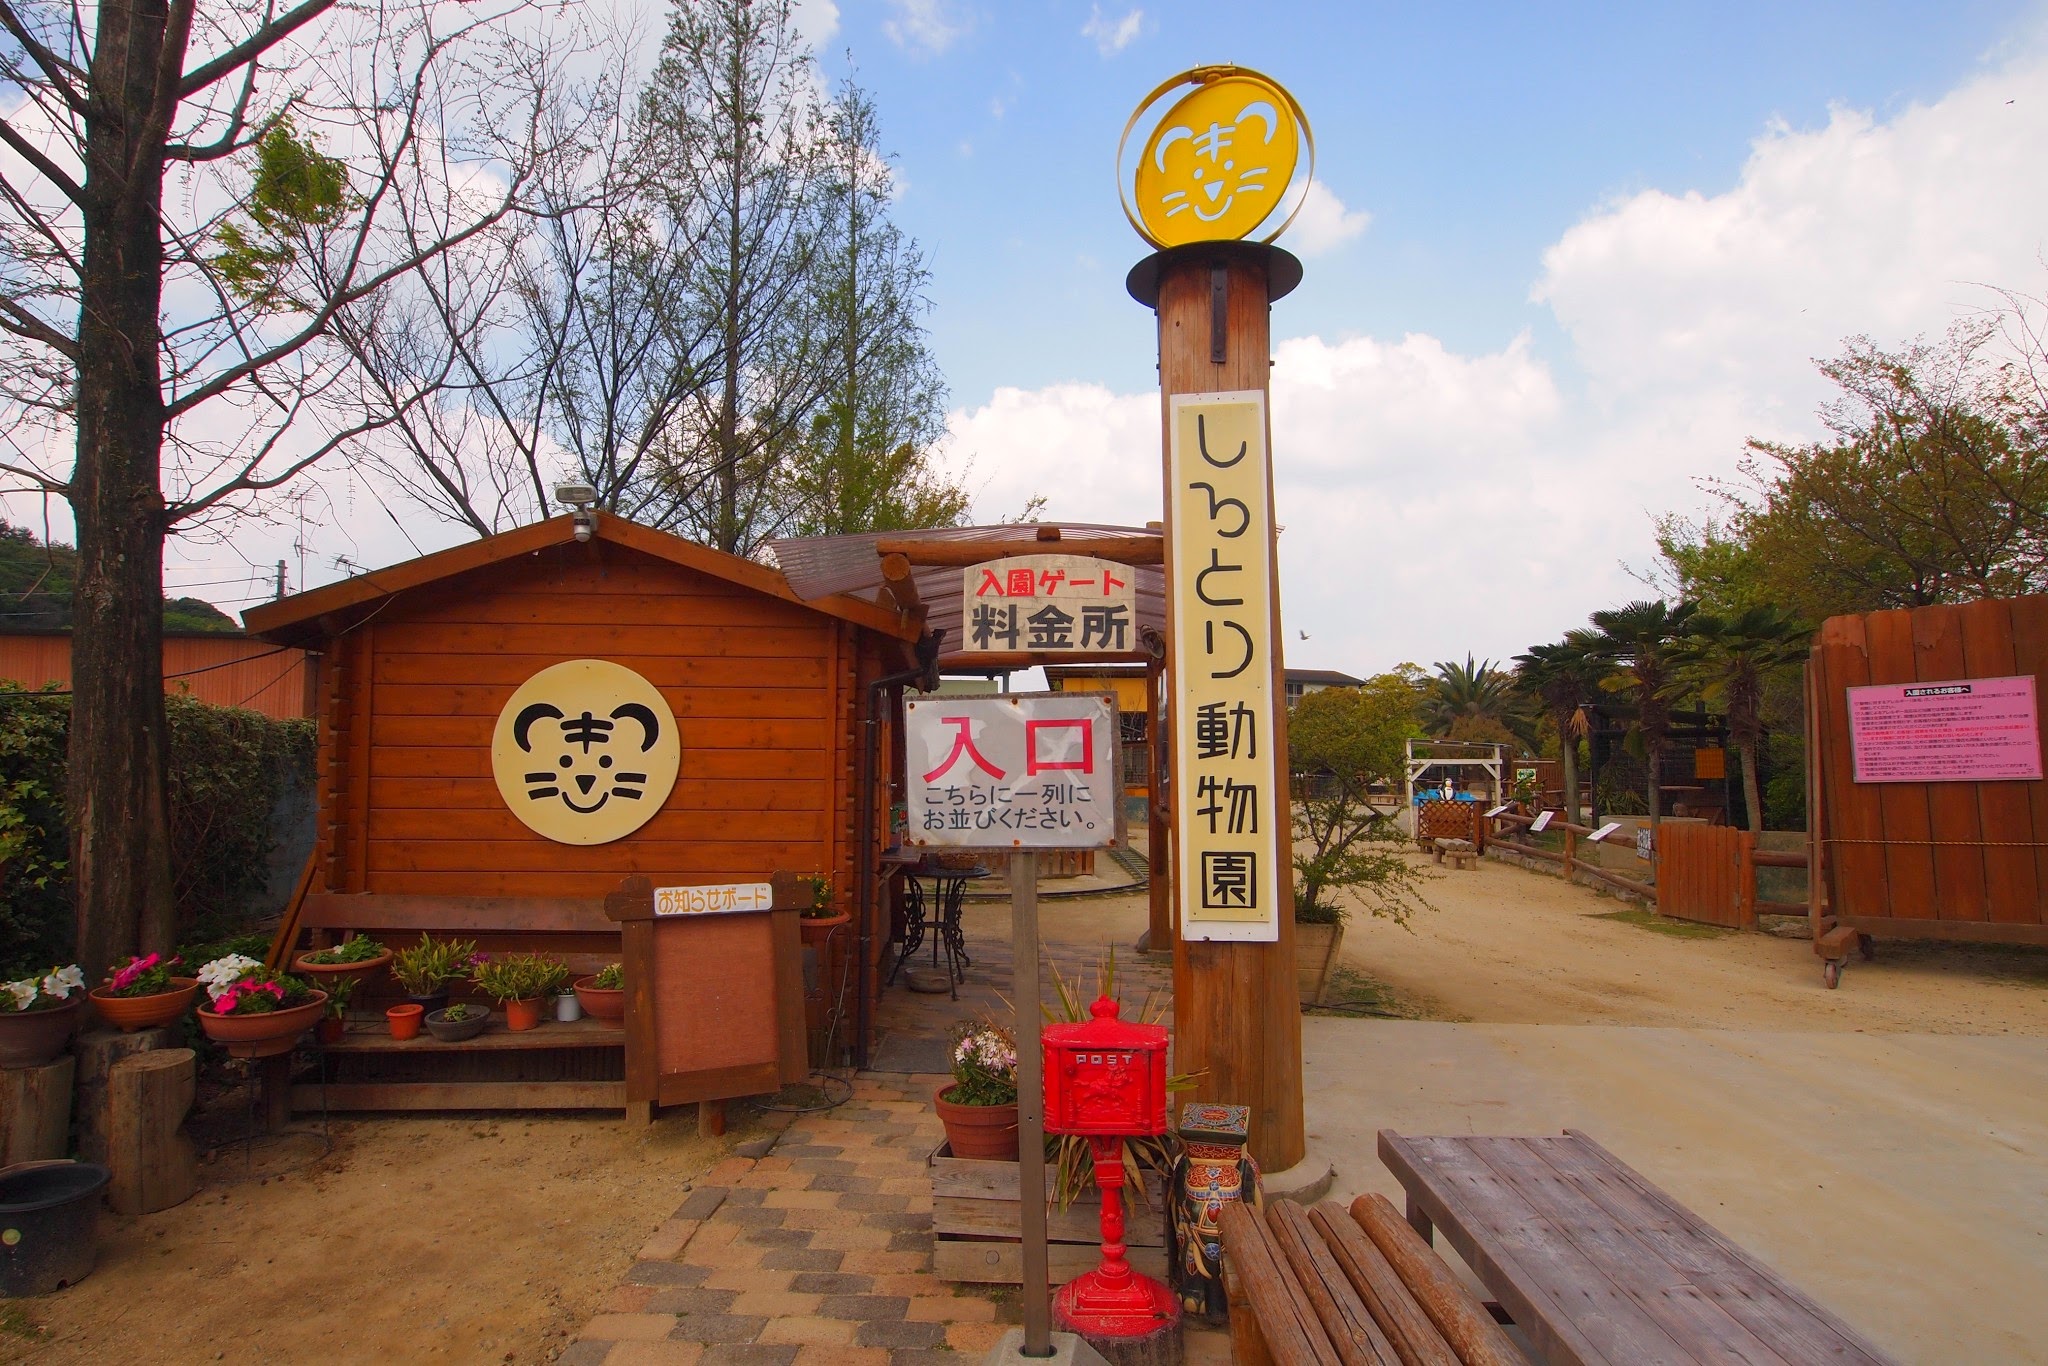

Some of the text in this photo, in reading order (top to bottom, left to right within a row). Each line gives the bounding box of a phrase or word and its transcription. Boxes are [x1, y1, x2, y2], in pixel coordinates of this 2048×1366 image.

[976, 569, 1125, 597] 入園ゲート
[972, 604, 1129, 650] 料金所
[1189, 413, 1258, 909] しろとり動物園
[922, 717, 1094, 783] 入口
[925, 783, 1092, 806] こちらに一列に
[923, 808, 1095, 830] お並びください。
[658, 888, 767, 913] お知らせボード
[1076, 1054, 1132, 1065] POST
